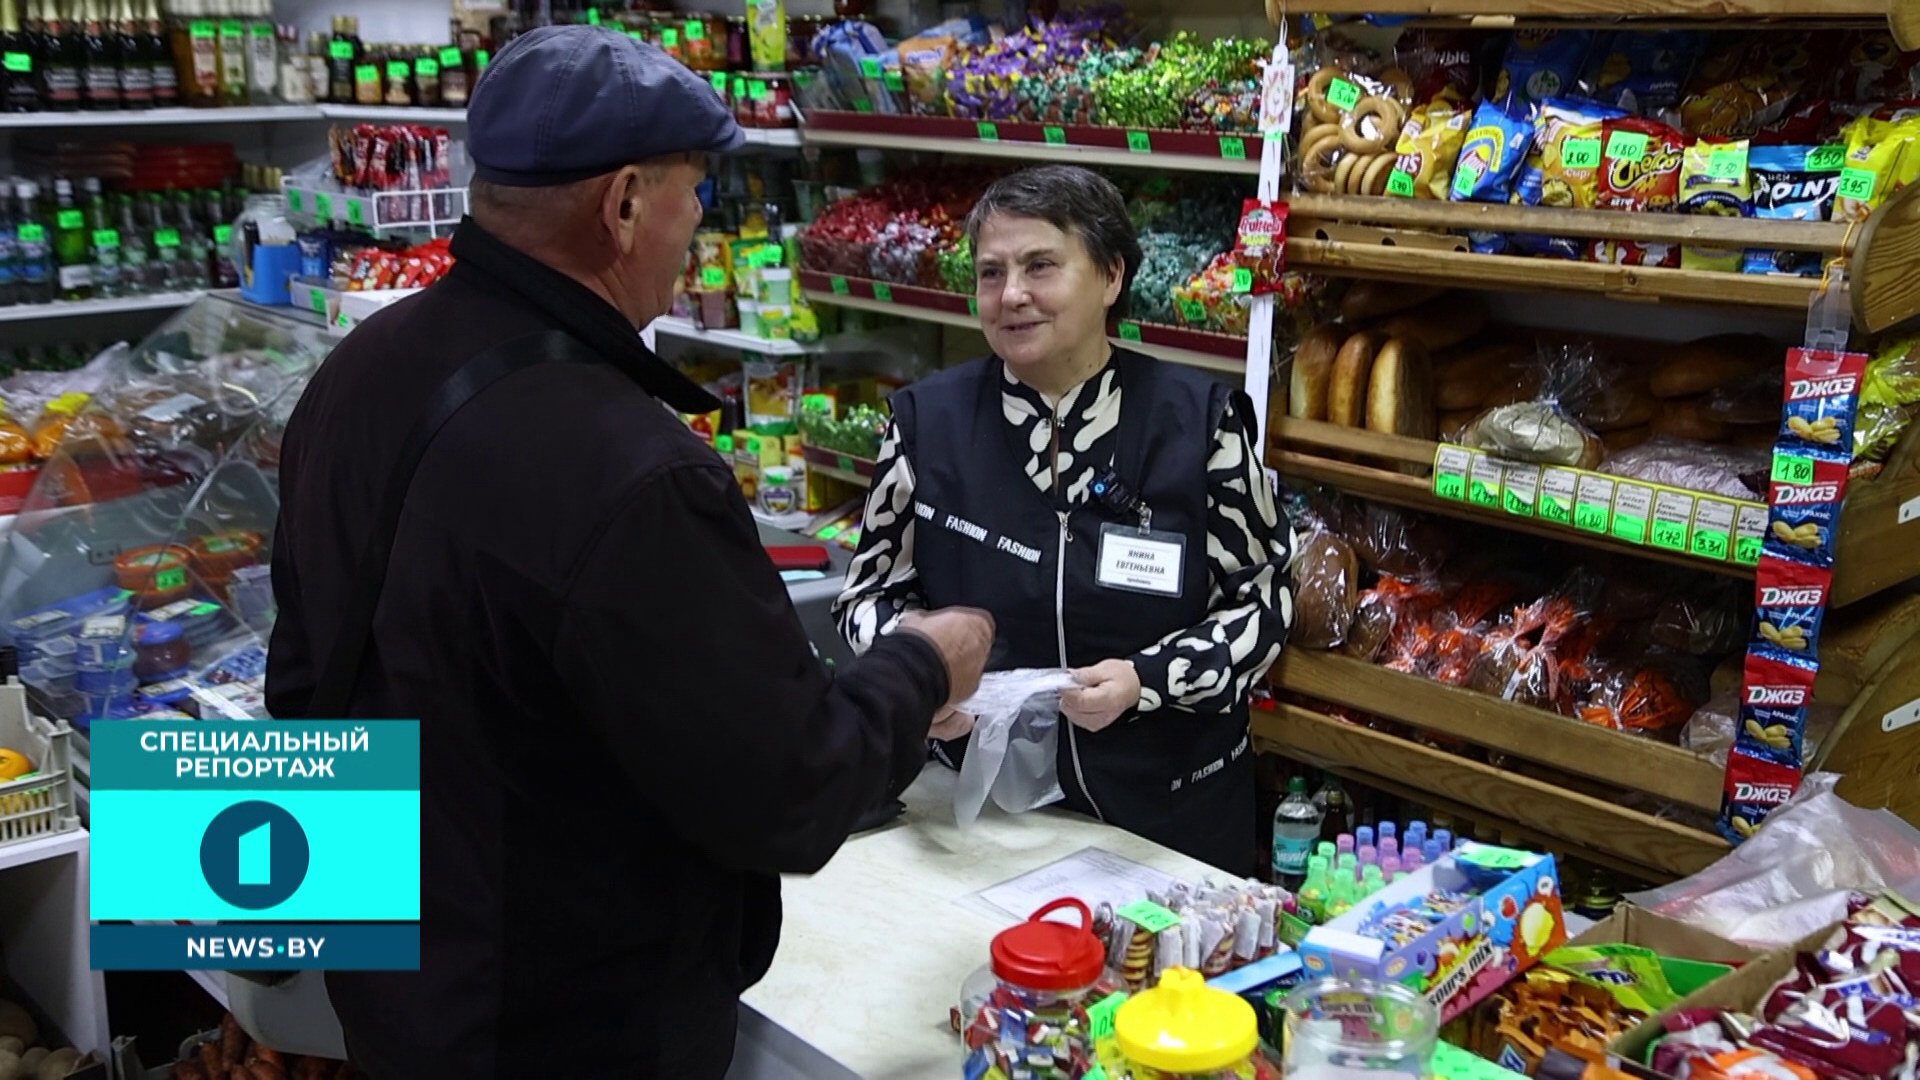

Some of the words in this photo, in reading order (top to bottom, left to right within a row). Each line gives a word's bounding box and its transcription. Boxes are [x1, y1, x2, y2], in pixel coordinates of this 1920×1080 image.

[945, 514, 988, 542] FASHION
[997, 535, 1042, 563] FASHION
[1126, 549, 1155, 561] ЯНИНА
[1115, 560, 1165, 575] ЕВГЕНЬЕВНА
